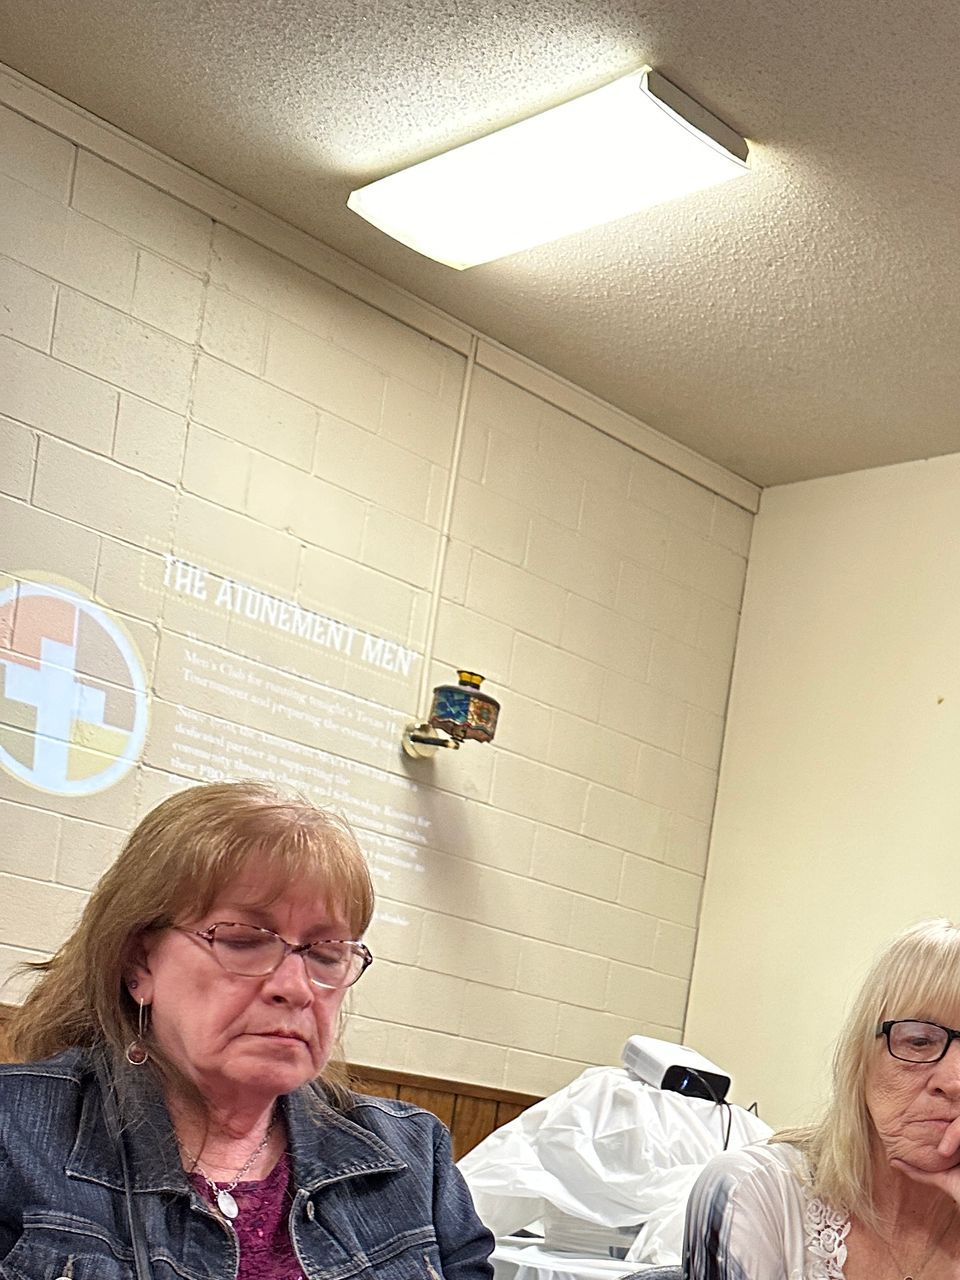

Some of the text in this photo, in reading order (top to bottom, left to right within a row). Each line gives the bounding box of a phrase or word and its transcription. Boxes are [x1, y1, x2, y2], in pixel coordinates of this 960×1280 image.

[162, 555, 207, 601] THE
[215, 576, 359, 656] ATONEMENT
[361, 632, 419, 677] MEN
